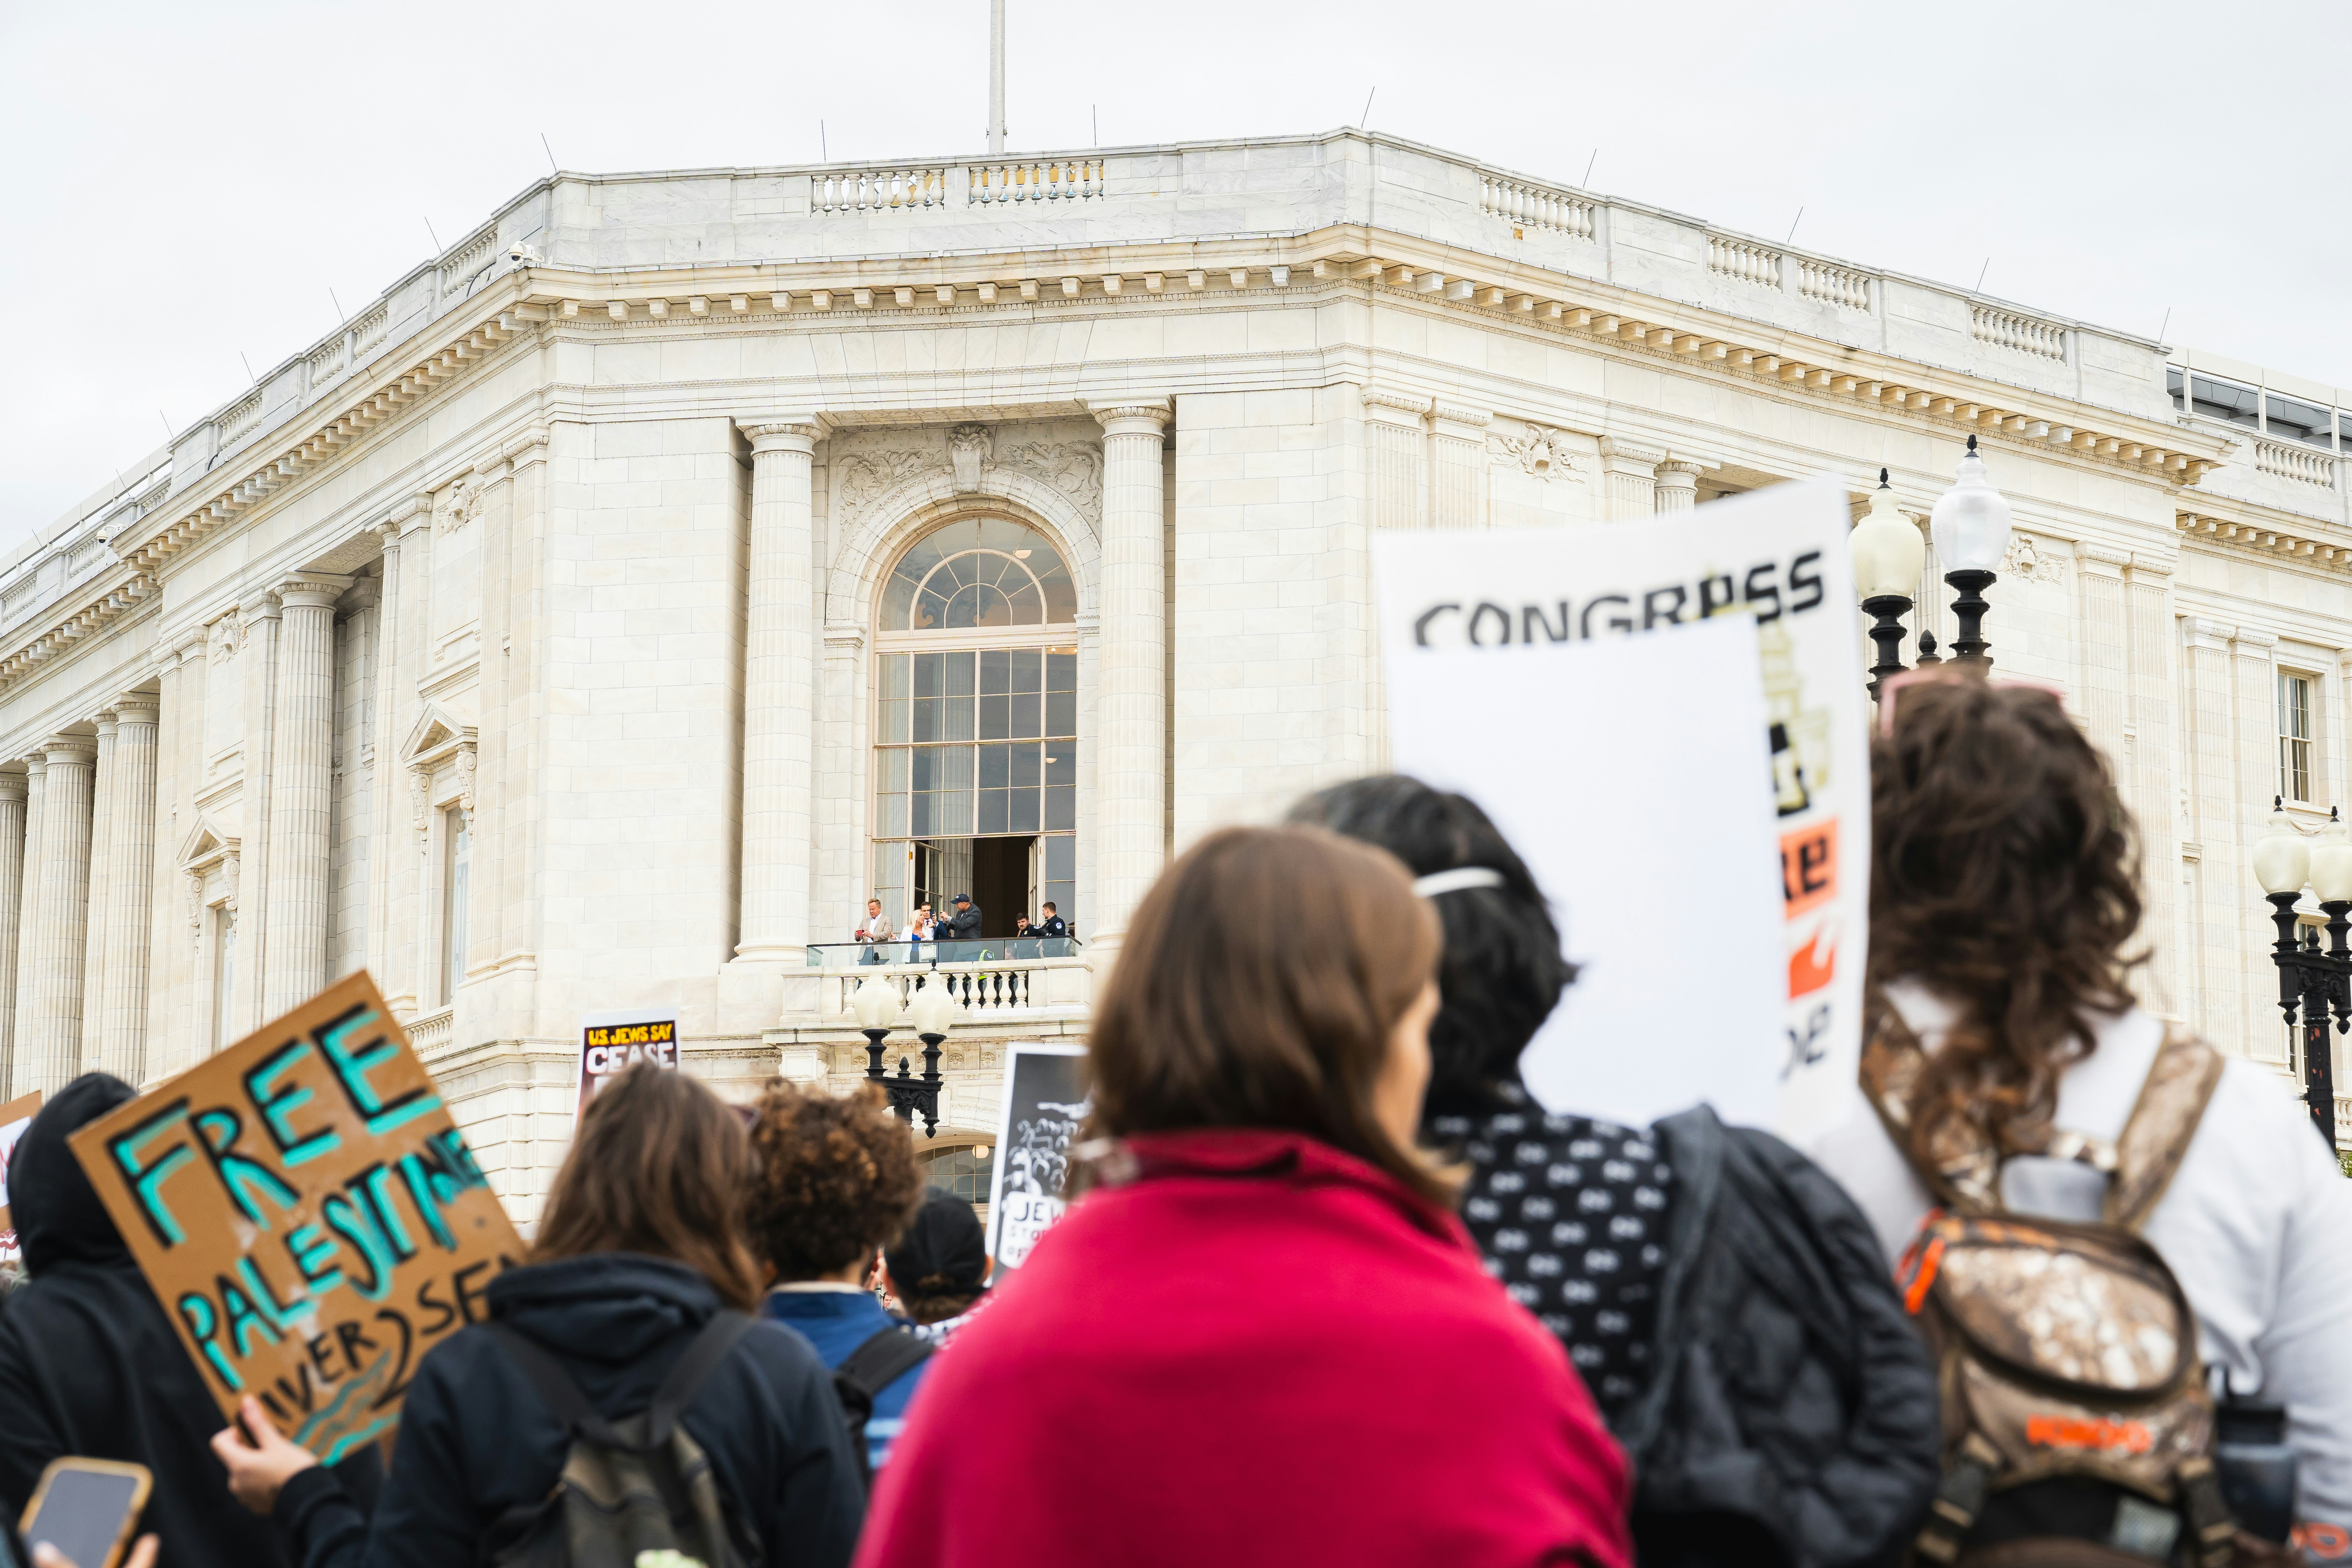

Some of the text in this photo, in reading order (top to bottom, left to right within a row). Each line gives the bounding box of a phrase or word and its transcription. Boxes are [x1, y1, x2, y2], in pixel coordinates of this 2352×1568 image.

[586, 1042, 676, 1074] CEASE
[610, 1026, 649, 1045] JEWS
[650, 1023, 672, 1041] SAY
[106, 1002, 442, 1250] FREE
[418, 1253, 516, 1336] SE
